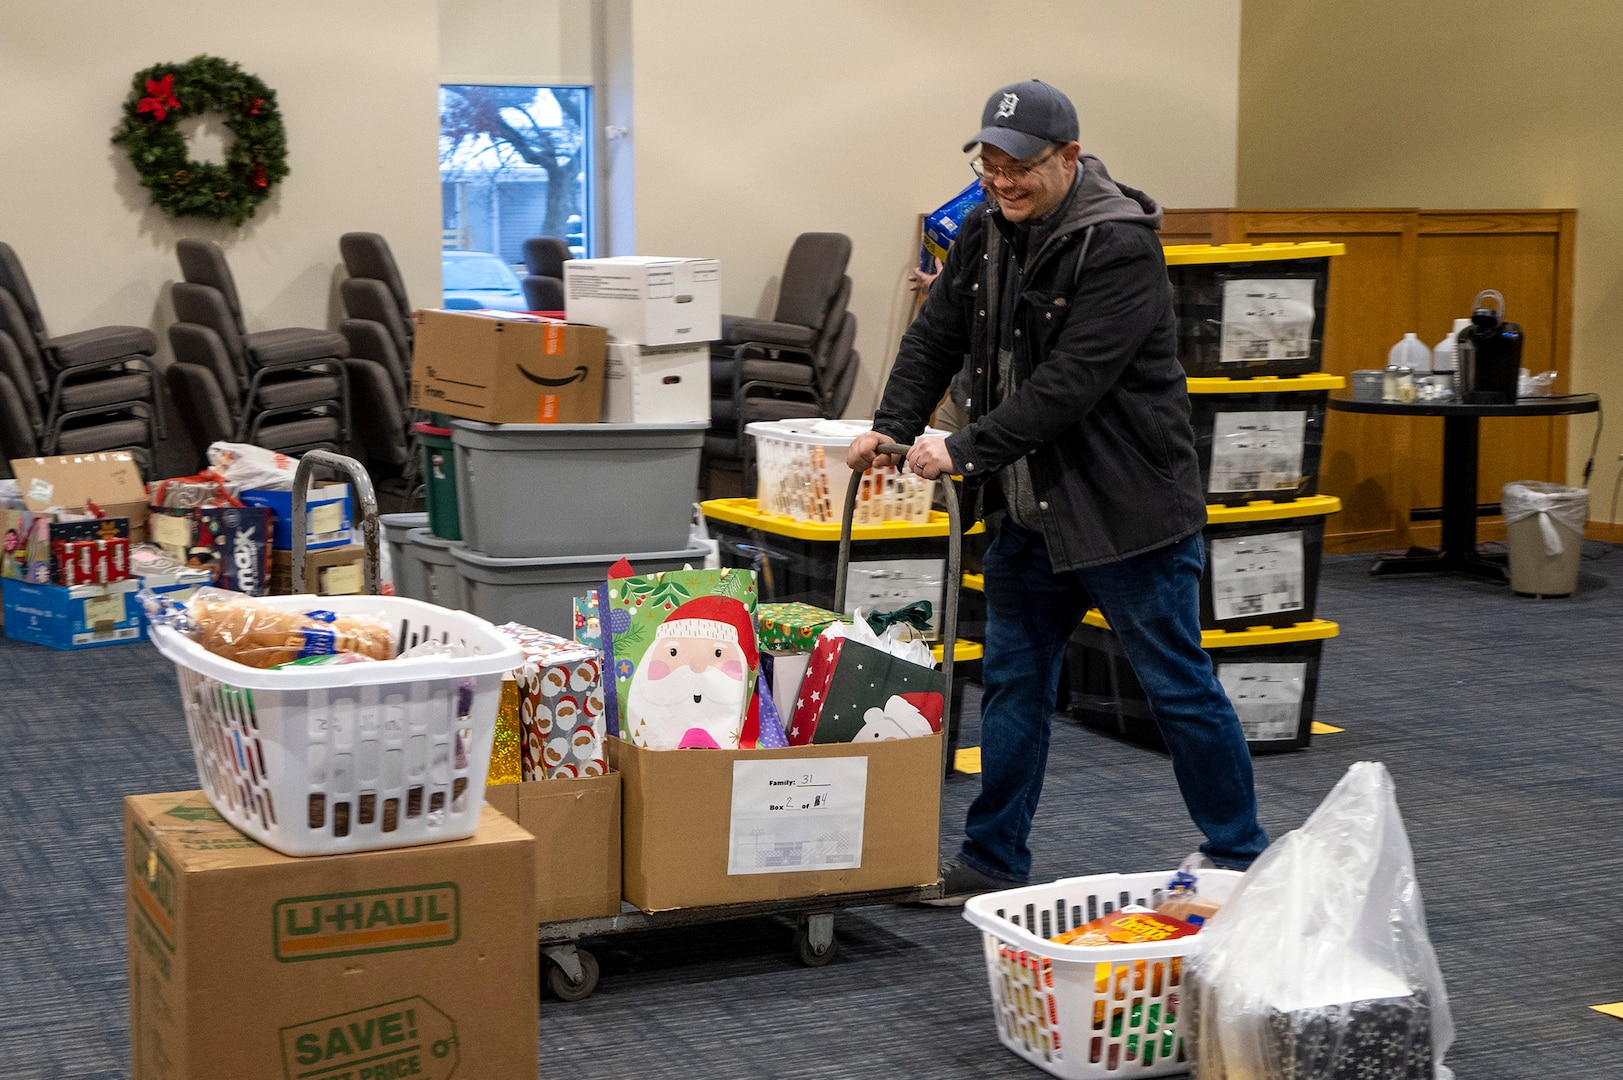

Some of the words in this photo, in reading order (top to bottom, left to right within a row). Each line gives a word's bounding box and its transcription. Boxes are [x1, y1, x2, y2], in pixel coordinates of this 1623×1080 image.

[993, 92, 1019, 119] D
[769, 779, 796, 787] Family:
[801, 774, 813, 784] 31
[785, 796, 794, 808] 2
[295, 1009, 419, 1066] SAVE!
